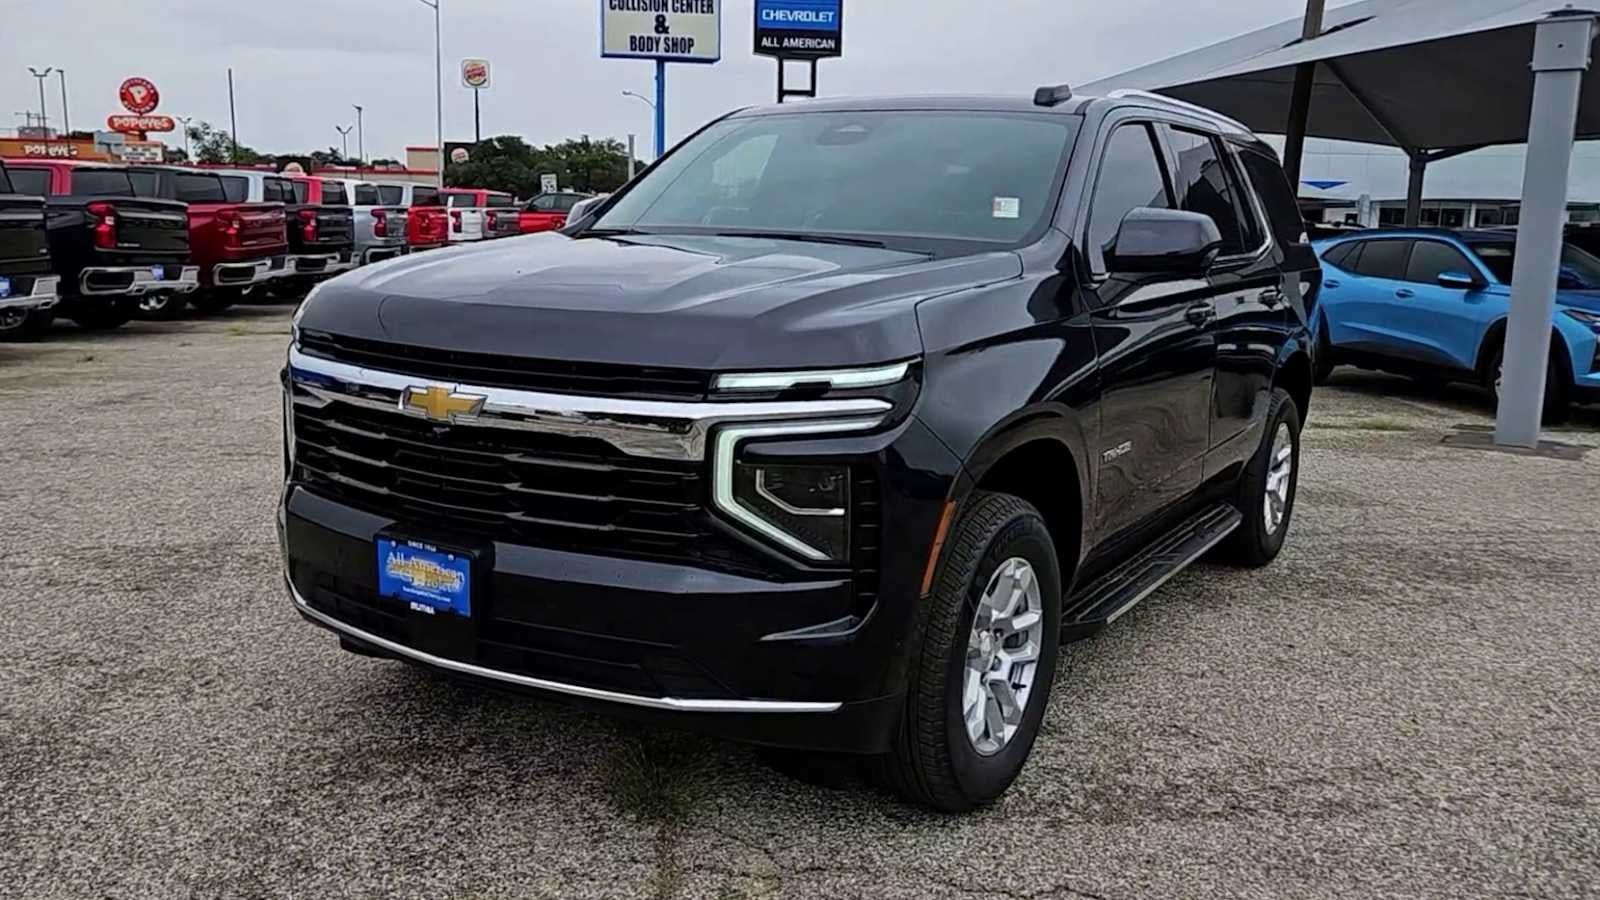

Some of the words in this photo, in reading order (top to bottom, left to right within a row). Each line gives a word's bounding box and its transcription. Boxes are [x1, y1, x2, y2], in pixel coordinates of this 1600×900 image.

[609, 0, 668, 13] COLLISION
[671, 0, 714, 15] CENTER
[762, 9, 835, 23] CHEVROLET
[654, 14, 670, 35] &
[629, 35, 661, 53] BODY
[663, 36, 695, 54] SHOP
[761, 36, 781, 48] ALL
[783, 37, 836, 49] AMERICAN
[387, 552, 404, 565] All
